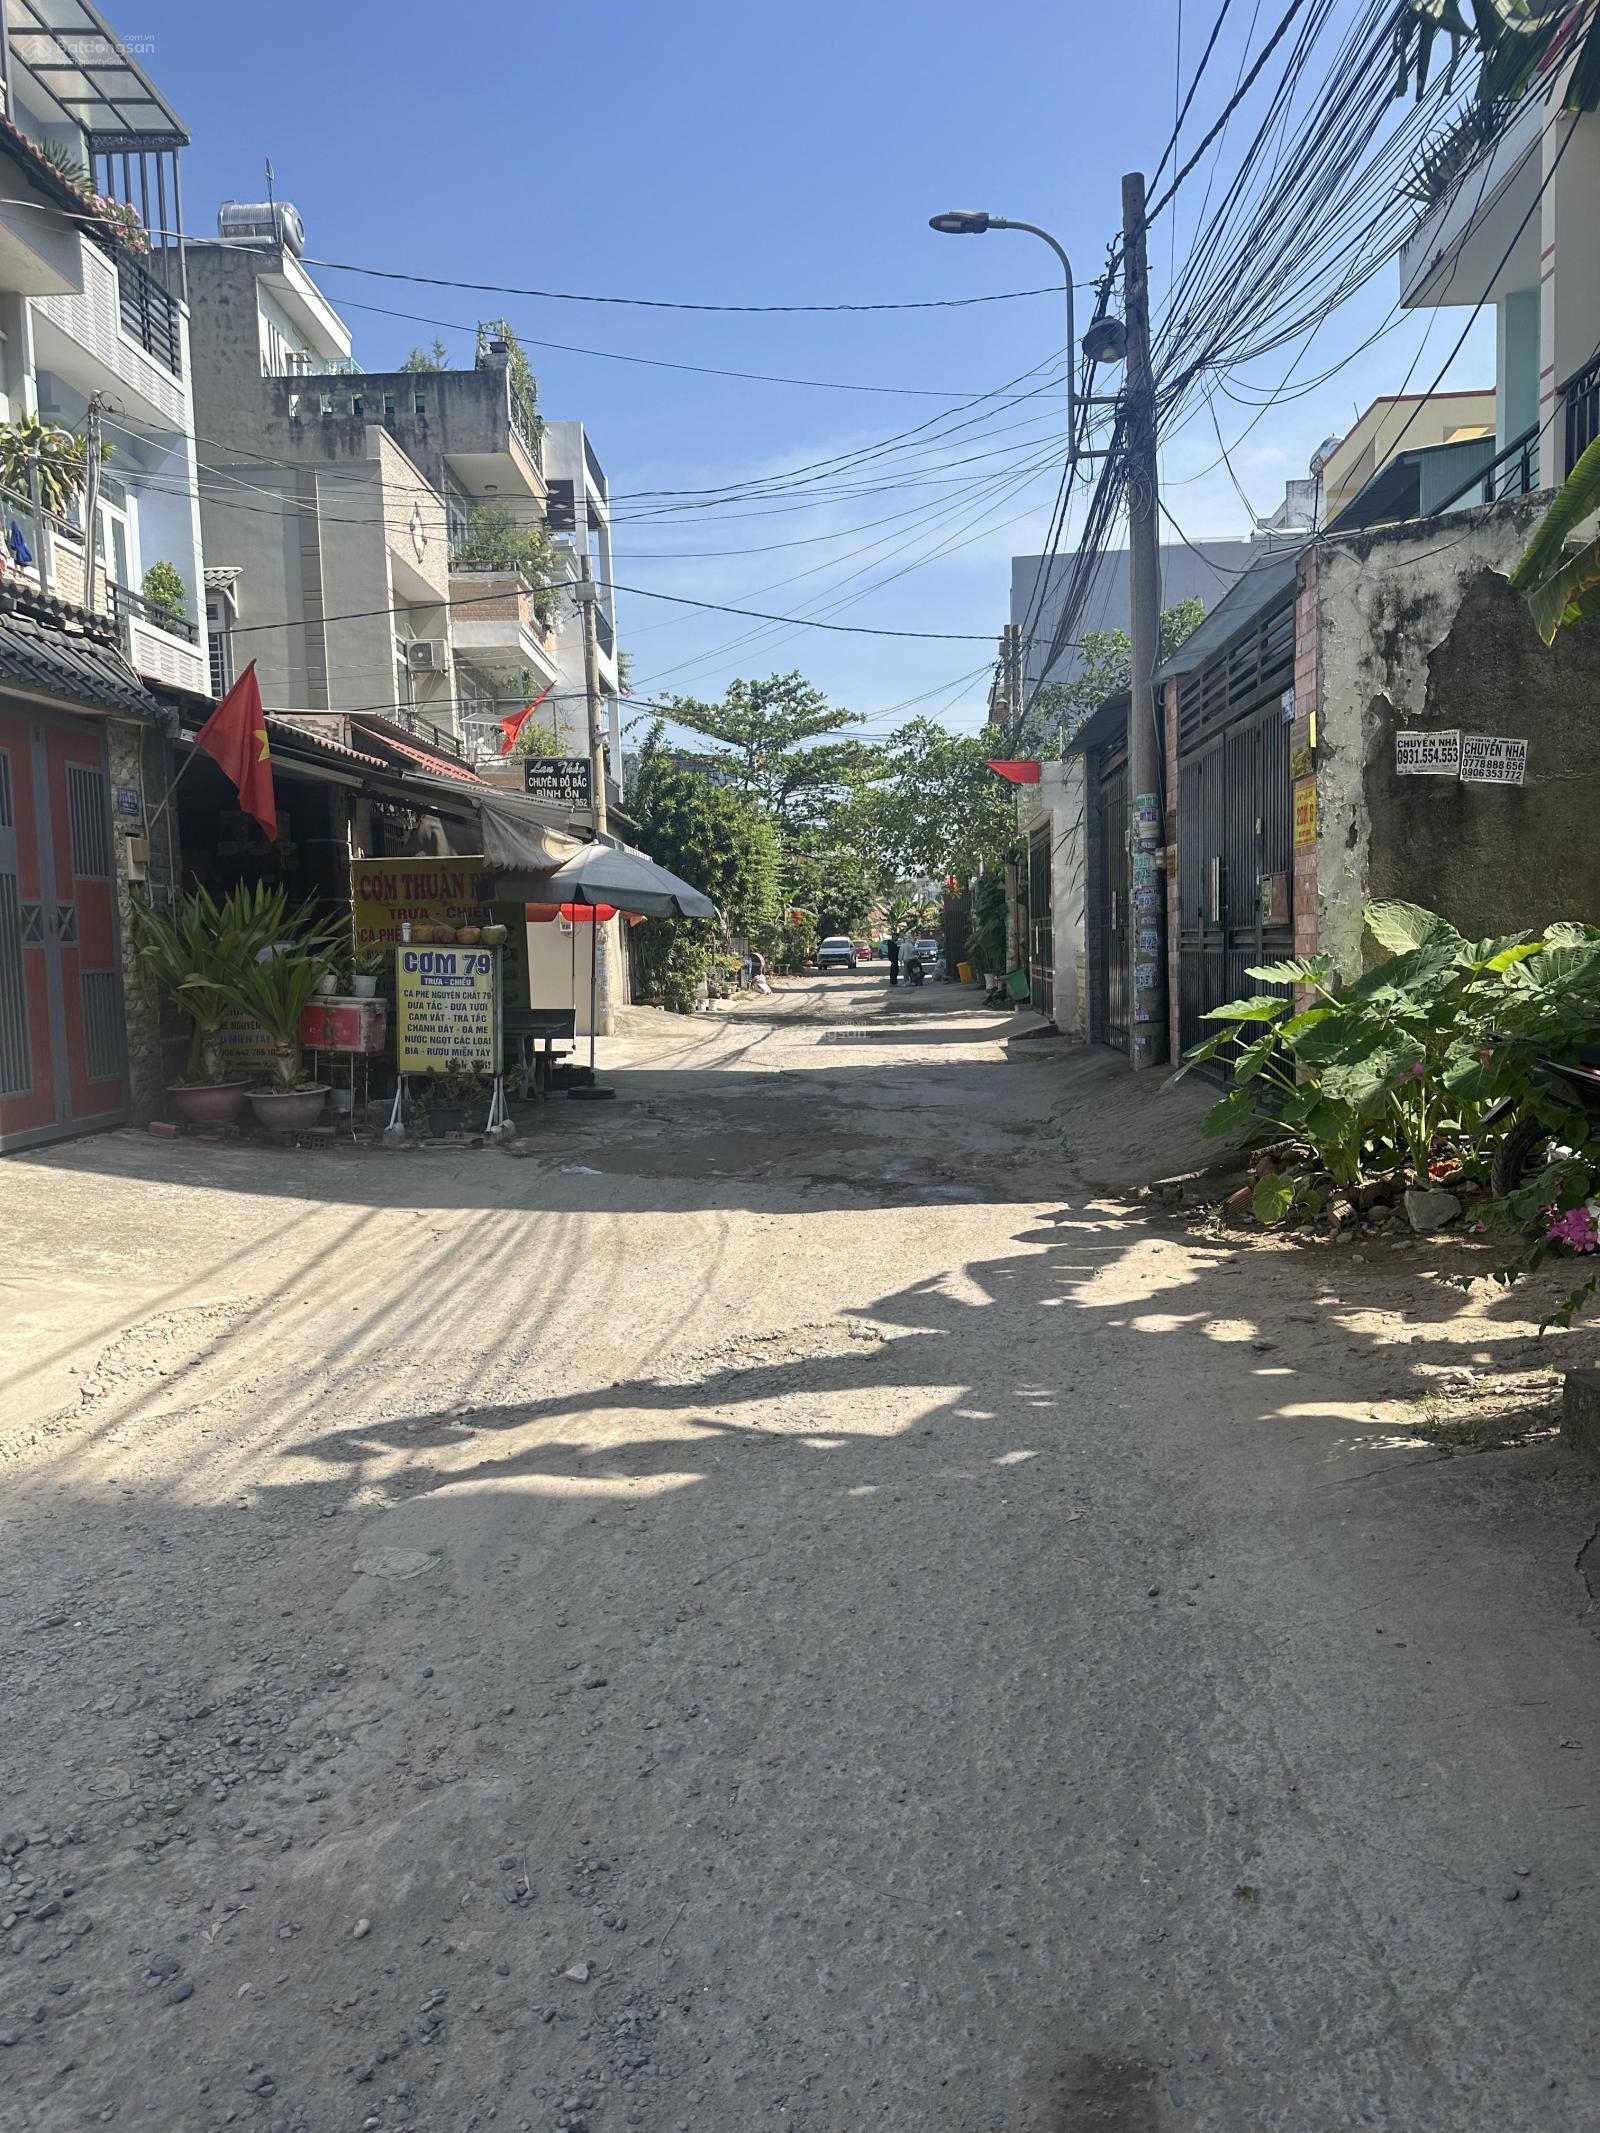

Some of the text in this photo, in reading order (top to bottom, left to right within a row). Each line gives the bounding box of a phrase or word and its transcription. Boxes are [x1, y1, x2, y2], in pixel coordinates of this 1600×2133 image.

[1397, 734, 1458, 748] CHUYỂN NHÀ
[1464, 738, 1526, 759] CHUYỂN NHÀ
[1397, 747, 1459, 765] 0931.554.553
[528, 776, 558, 787] CHUYÊN
[360, 870, 398, 900] CƠM
[401, 866, 465, 905] THUẬN
[388, 906, 429, 920] TRƯA
[404, 951, 456, 974] CƠM
[464, 954, 491, 974] 79
[424, 977, 443, 985] TRƯA
[409, 1013, 427, 1021] CAM
[407, 1024, 435, 1032] CHANH
[430, 1036, 451, 1046] NGỌT
[404, 1047, 418, 1055] BIA
